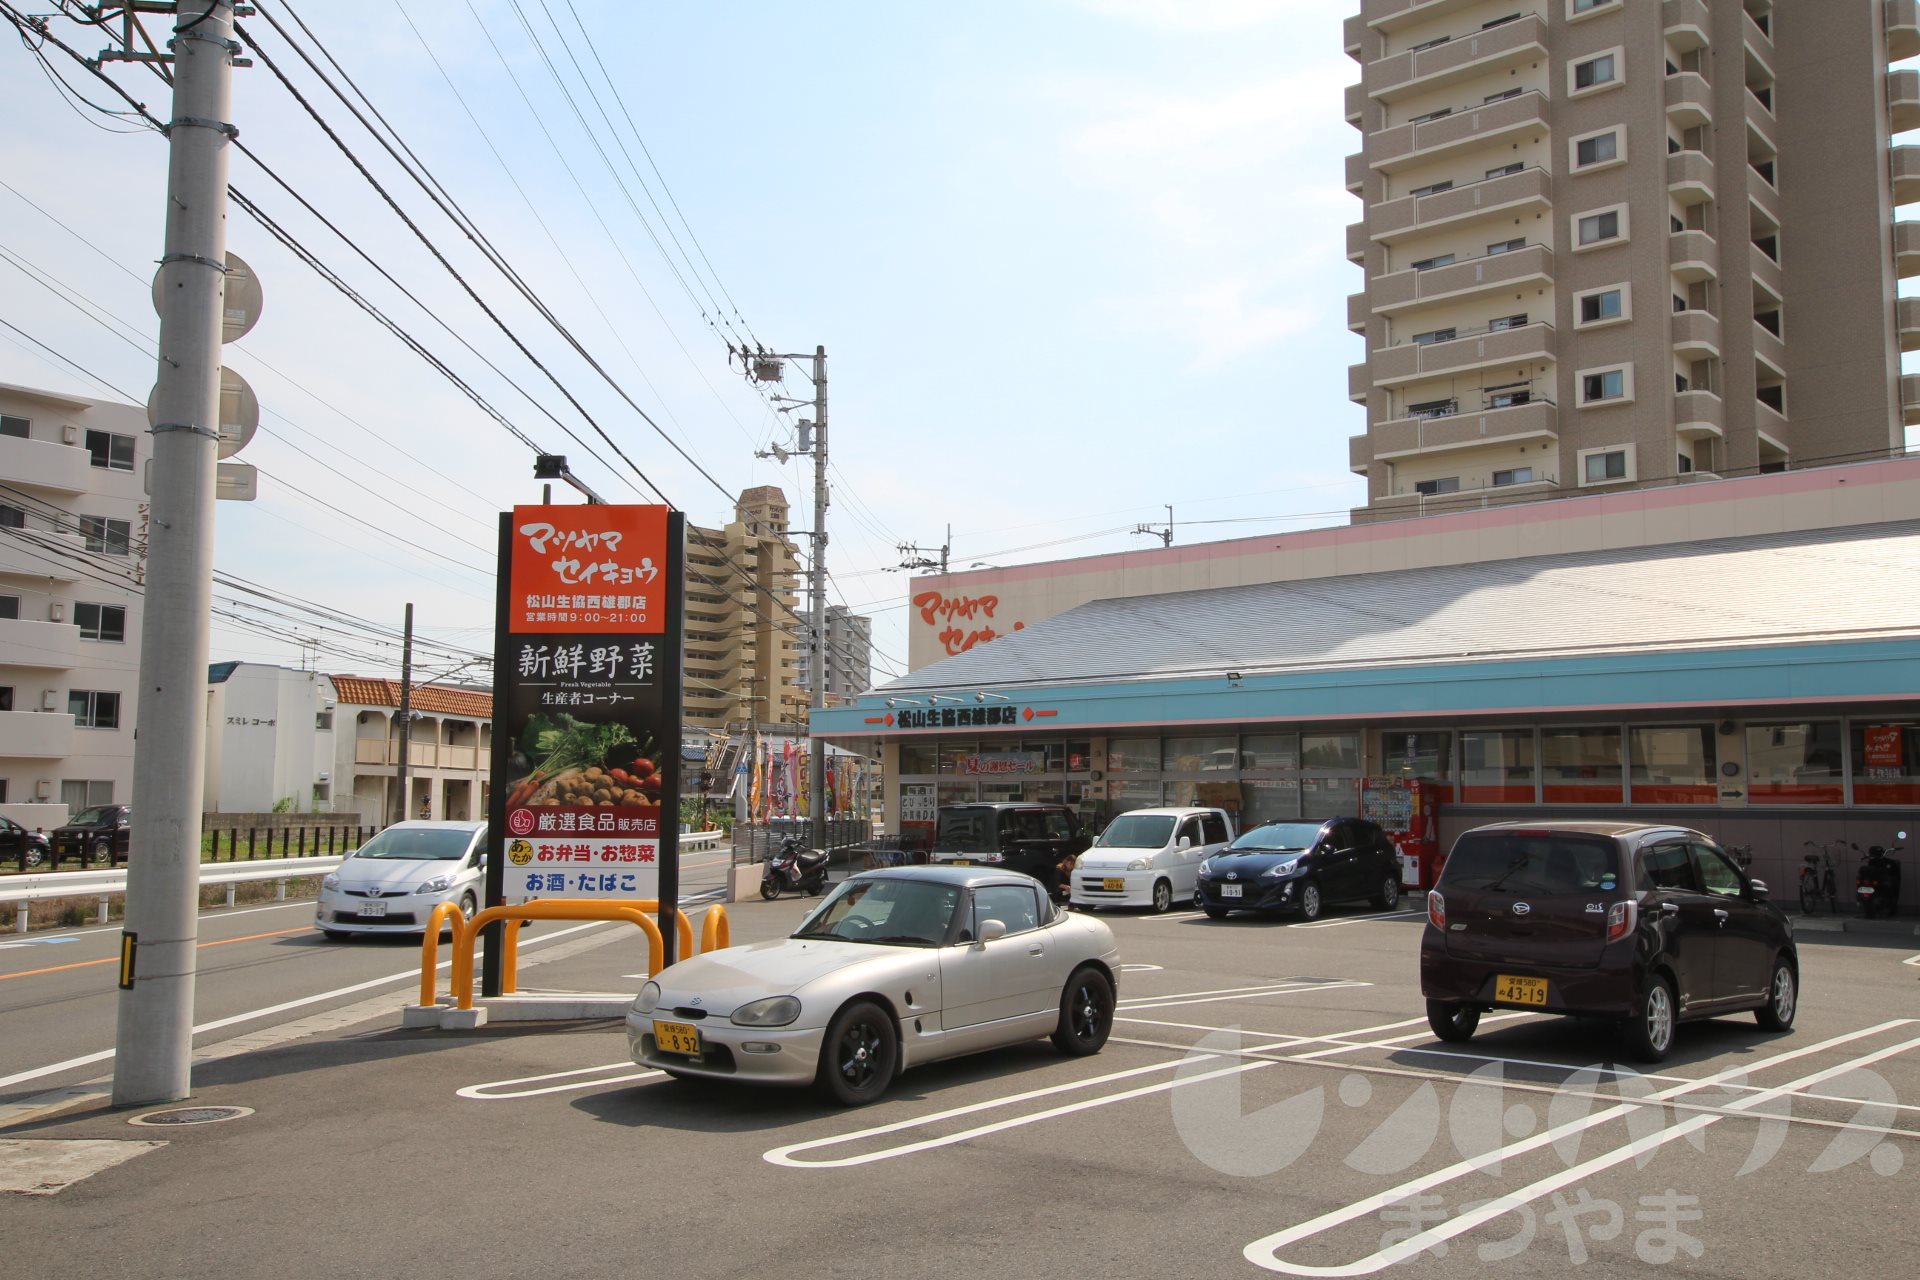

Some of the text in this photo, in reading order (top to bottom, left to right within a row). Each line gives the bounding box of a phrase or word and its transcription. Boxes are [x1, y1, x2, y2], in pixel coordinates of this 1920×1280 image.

[519, 522, 623, 555] マツヤマ
[551, 555, 659, 585] セイキョウ
[526, 594, 647, 610] 松山生協西雄郡店
[912, 591, 999, 626] マツヤマ
[518, 641, 655, 680] 新鮮野菜
[580, 681, 612, 689] Vegetable
[541, 691, 635, 706] 生産者コーナー
[226, 716, 250, 726] スミレ
[537, 844, 656, 863] お弁当・お惣菜
[525, 873, 637, 892] お酒・たばこ
[1506, 986, 1545, 1003] 43-19
